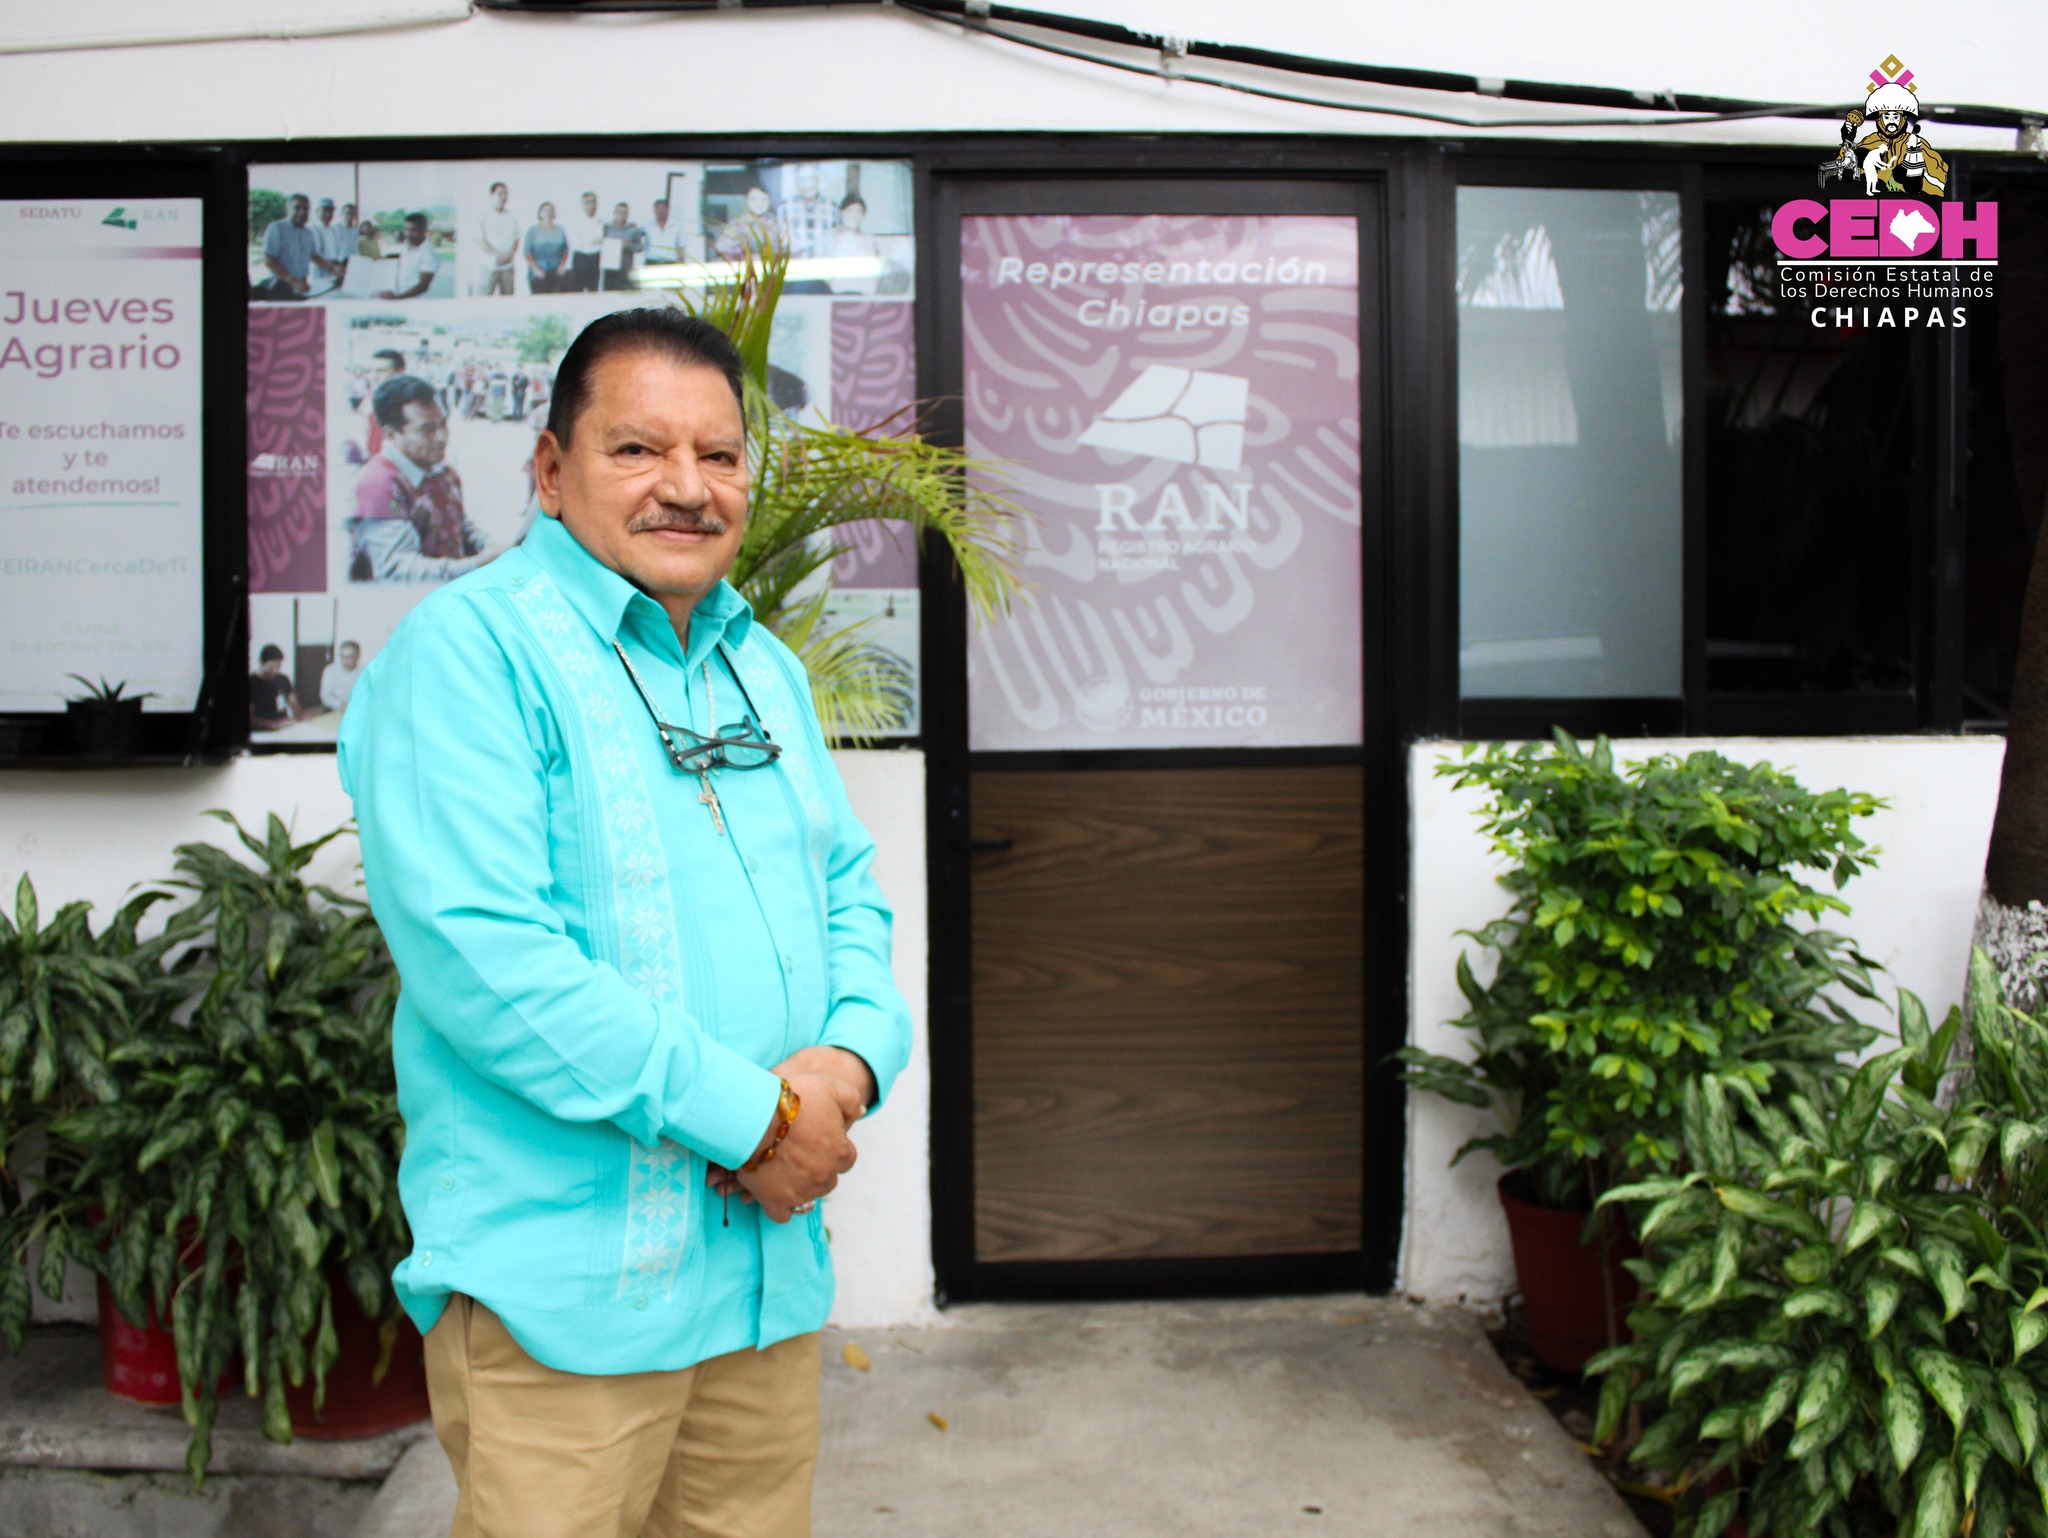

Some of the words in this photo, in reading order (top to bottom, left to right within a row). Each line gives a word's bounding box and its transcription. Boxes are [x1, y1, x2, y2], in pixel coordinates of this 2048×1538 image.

[19, 207, 82, 220] SEDATU
[997, 256, 1328, 288] Representación
[3, 290, 175, 324] Jueves
[1077, 299, 1252, 333] Chiapas
[0, 334, 181, 378] Agrario
[28, 420, 186, 440] escuchamos
[63, 450, 77, 471] y
[84, 448, 109, 468] te
[277, 455, 319, 471] RAN
[12, 475, 161, 496] atendemos!
[1094, 482, 1254, 532] RAN
[1138, 686, 1238, 703] GOBIERNO
[1241, 686, 1267, 702] DE
[1140, 703, 1268, 729] MÉXICO
